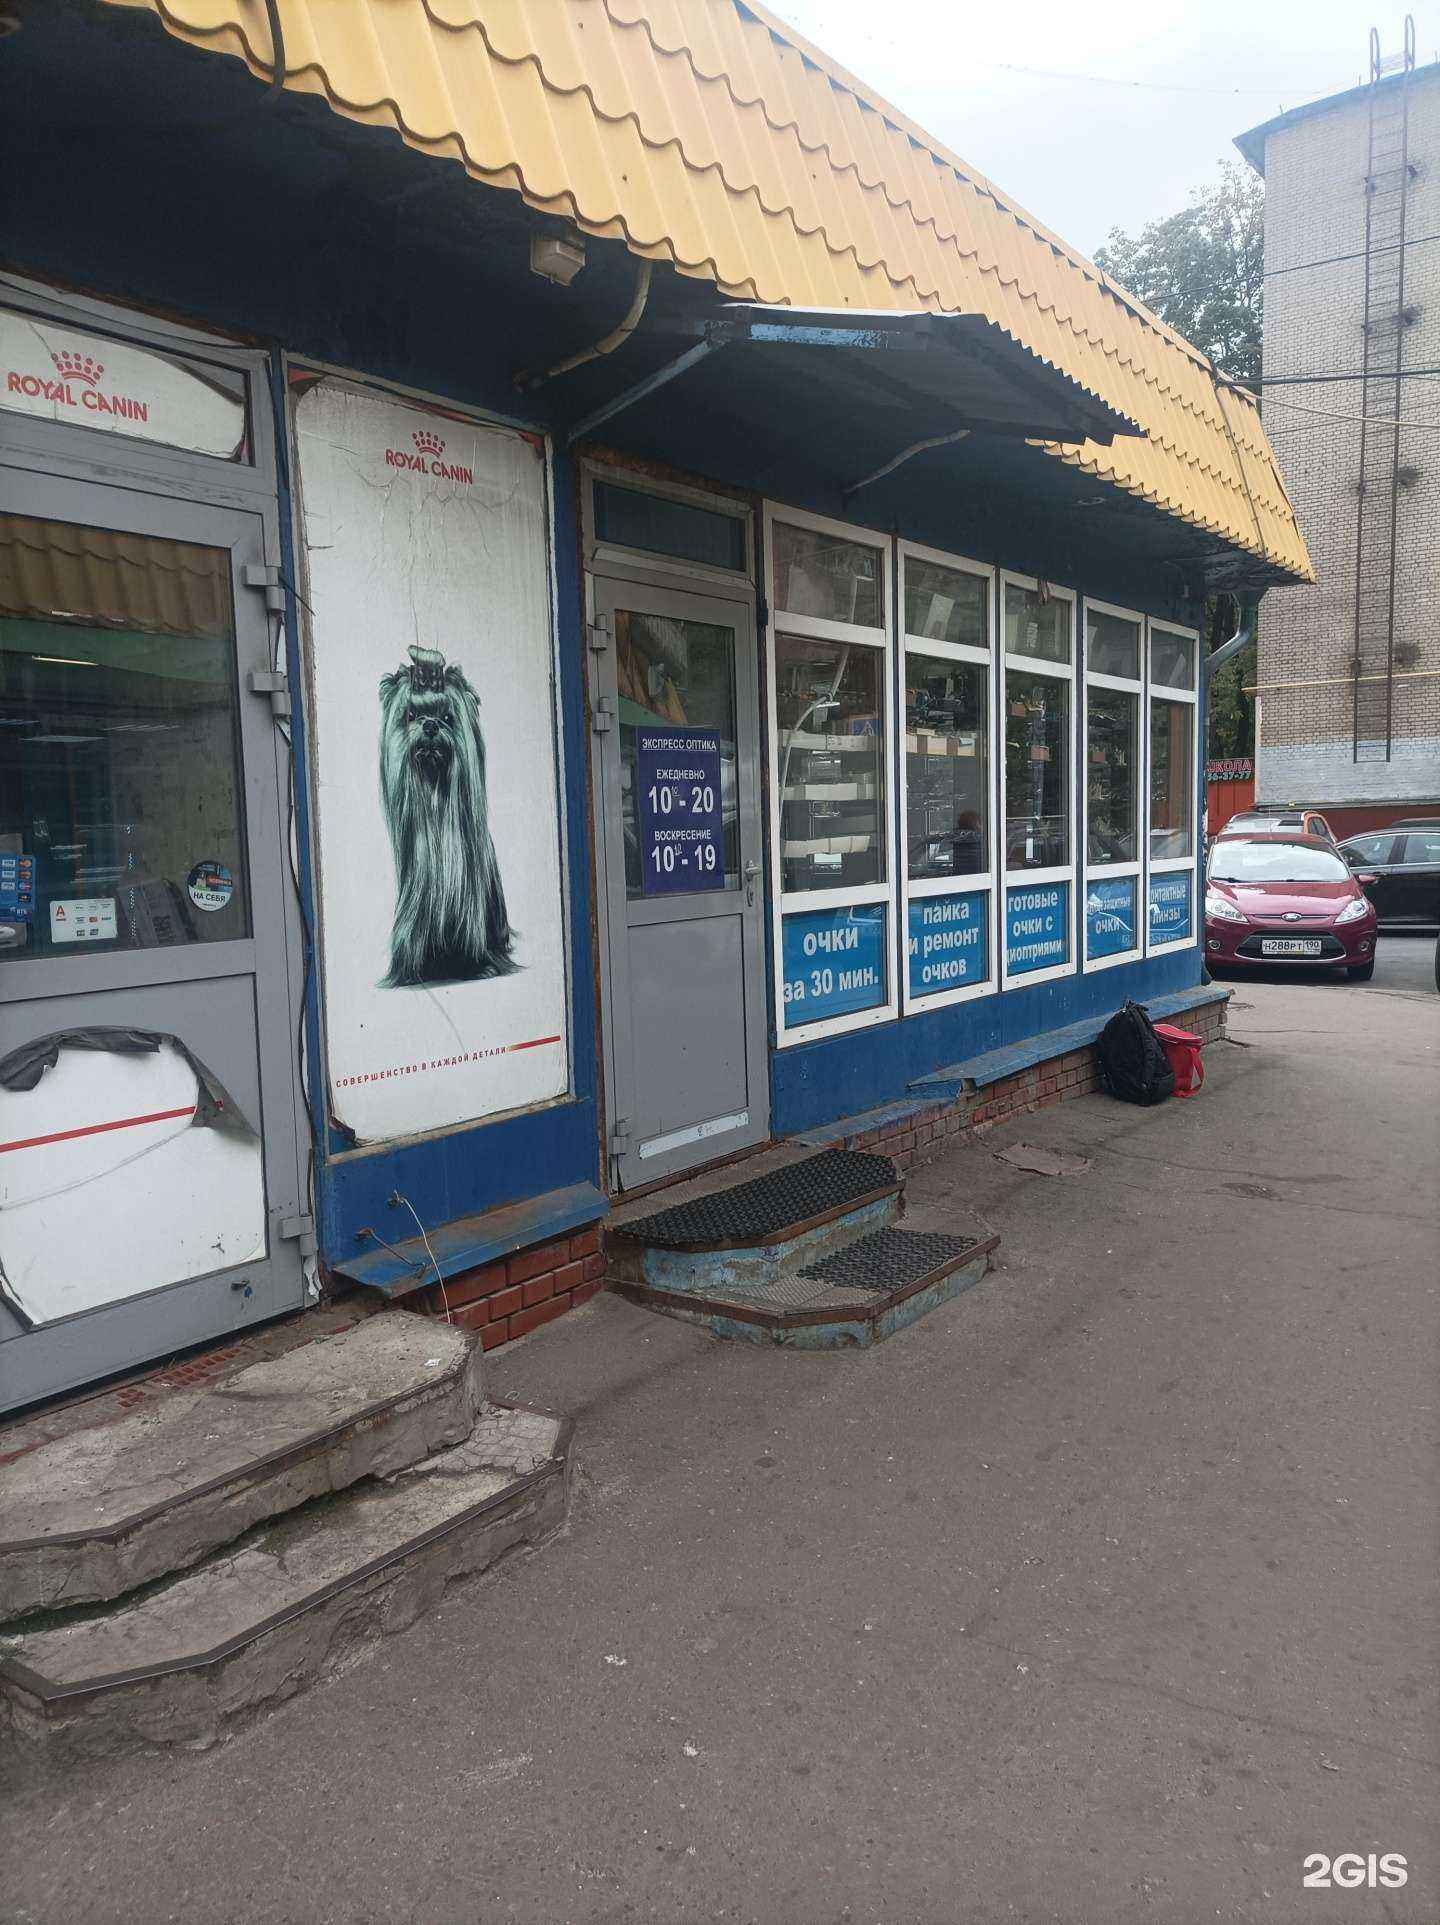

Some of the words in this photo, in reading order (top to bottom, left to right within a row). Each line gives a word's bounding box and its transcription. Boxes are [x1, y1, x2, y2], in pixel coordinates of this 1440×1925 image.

[8, 371, 77, 406] ROYAL
[81, 389, 149, 422] CANIN
[386, 448, 429, 474] ROYAL
[431, 461, 473, 485] CANIN
[642, 738, 684, 749] ЭКСПРЕСС
[686, 739, 717, 751] ОПТИКА
[656, 769, 705, 781] ЕЖЕДНЕВНО
[692, 786, 714, 813] 20
[654, 829, 712, 841] ВОСКРЕСЕНИЕ
[695, 844, 716, 871] 19
[1008, 891, 1058, 913] готовые
[1150, 884, 1186, 903] онтактные
[923, 899, 970, 925] пайка
[1095, 915, 1120, 934] очки
[1152, 907, 1181, 925] линзы
[1013, 919, 1042, 937] очки
[803, 927, 858, 956] очки
[923, 927, 979, 958] ремонт
[922, 958, 967, 983] очков
[784, 980, 805, 1003] за
[811, 968, 833, 997] 30
[839, 967, 879, 991] мин.
[336, 1064, 418, 1088] СОВЕРШЕНСТВО
[421, 1062, 427, 1070] В
[430, 1053, 469, 1069] КАЖДОЙ
[472, 1046, 506, 1061] ДЕТАЛИ
